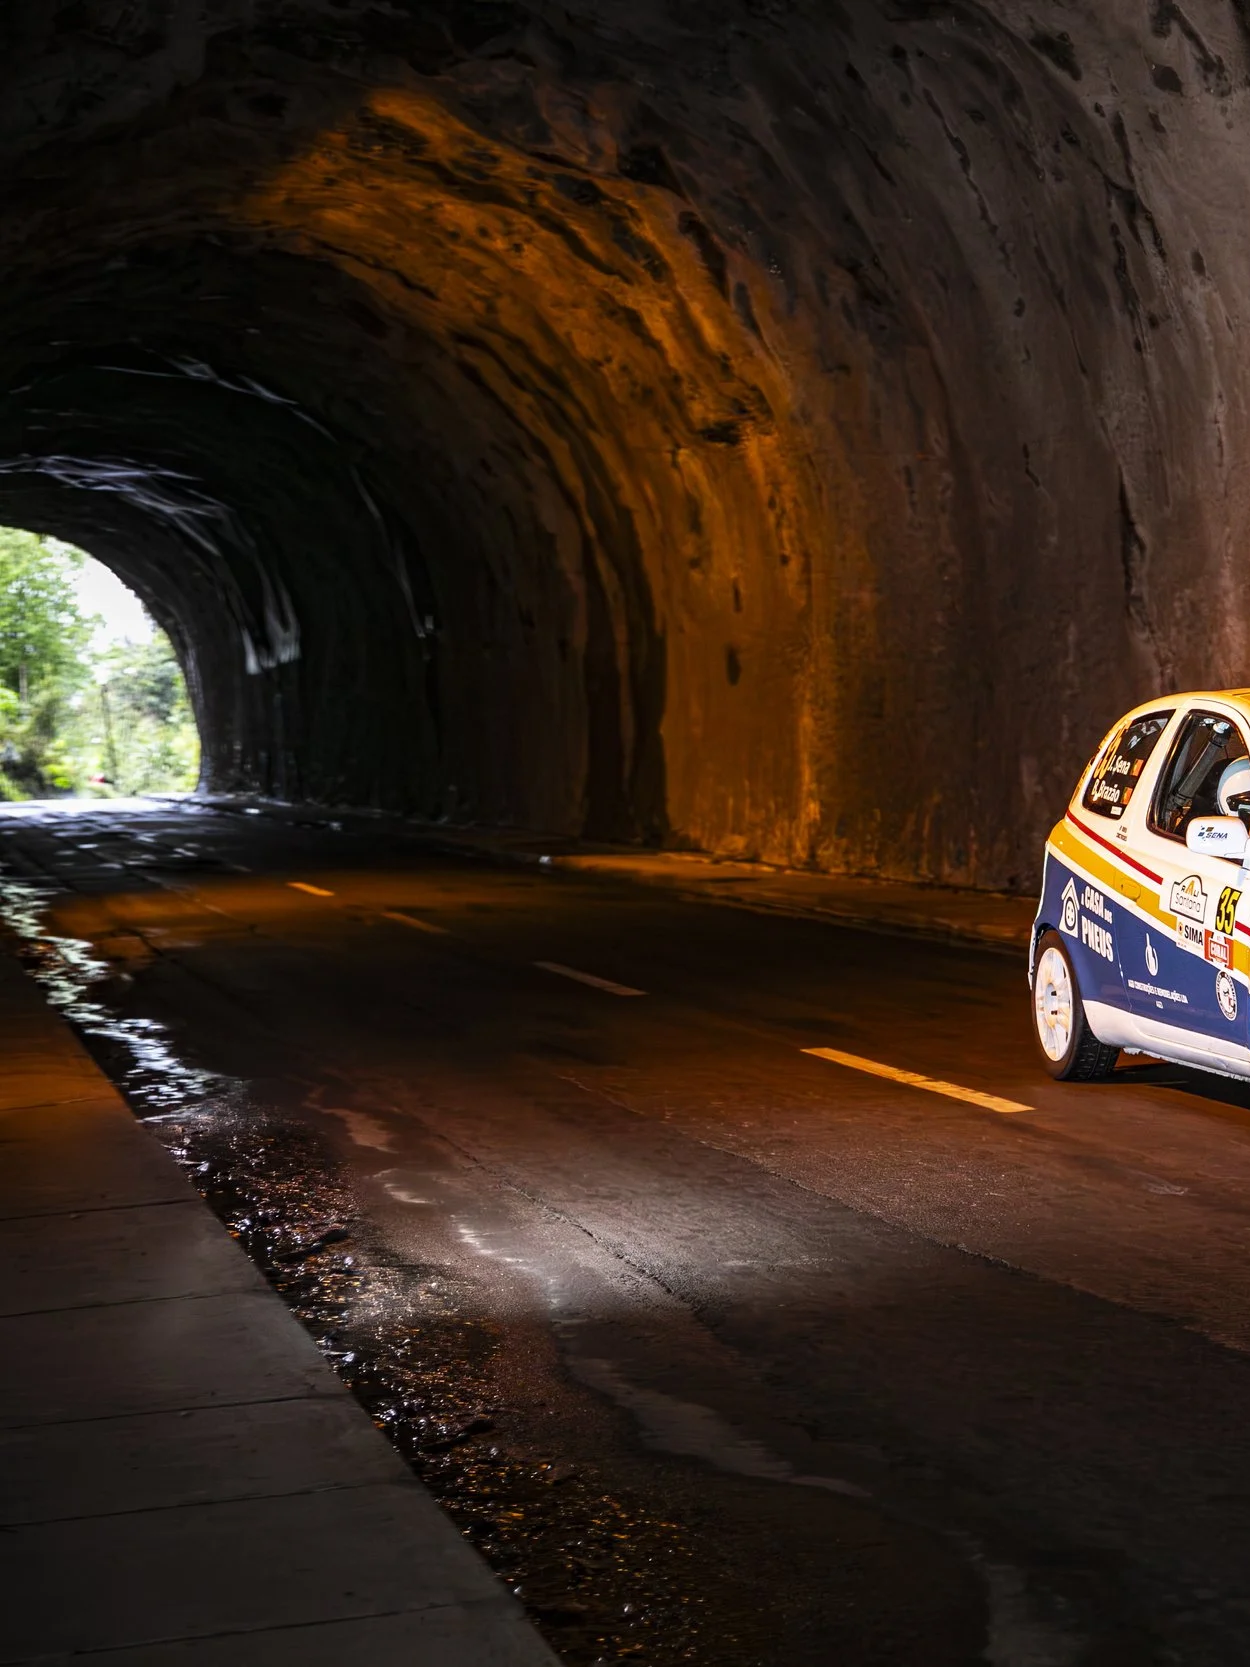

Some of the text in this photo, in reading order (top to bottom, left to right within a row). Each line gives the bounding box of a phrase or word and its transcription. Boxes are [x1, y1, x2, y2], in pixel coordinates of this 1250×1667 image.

[1115, 755, 1131, 776] Sena
[1084, 885, 1104, 919] CASA
[1180, 880, 1200, 898] RALI
[1216, 887, 1241, 935] 35
[1081, 915, 1114, 963] PNEUS
[1184, 924, 1204, 946] SIMA
